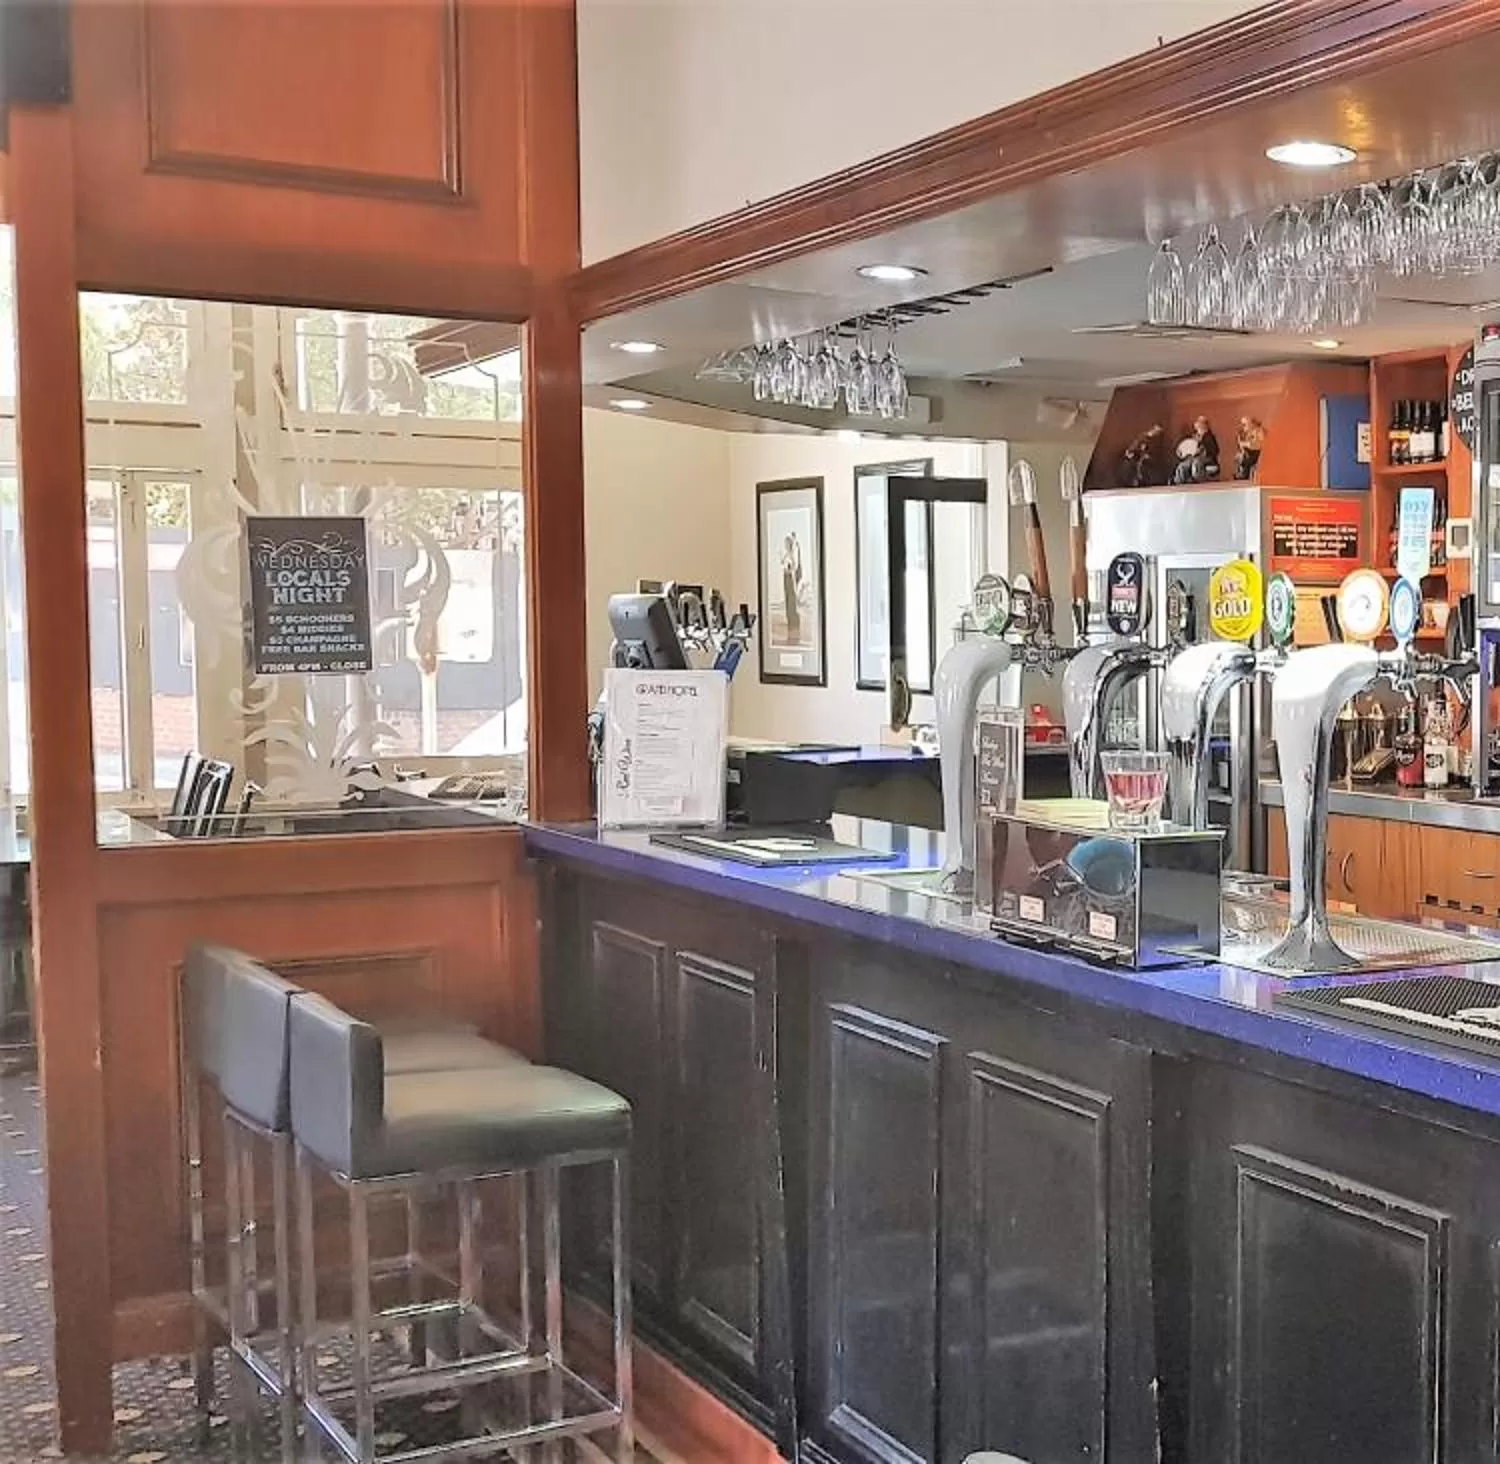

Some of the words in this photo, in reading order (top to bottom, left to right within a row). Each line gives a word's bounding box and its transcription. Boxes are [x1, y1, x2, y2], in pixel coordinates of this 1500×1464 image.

[257, 553, 364, 569] WEDNESDAY
[265, 570, 351, 587] LOCALS
[272, 587, 346, 604] NIGHT
[1111, 600, 1137, 614] NEW
[1212, 599, 1251, 620] GOLD
[261, 663, 295, 673] FROM
